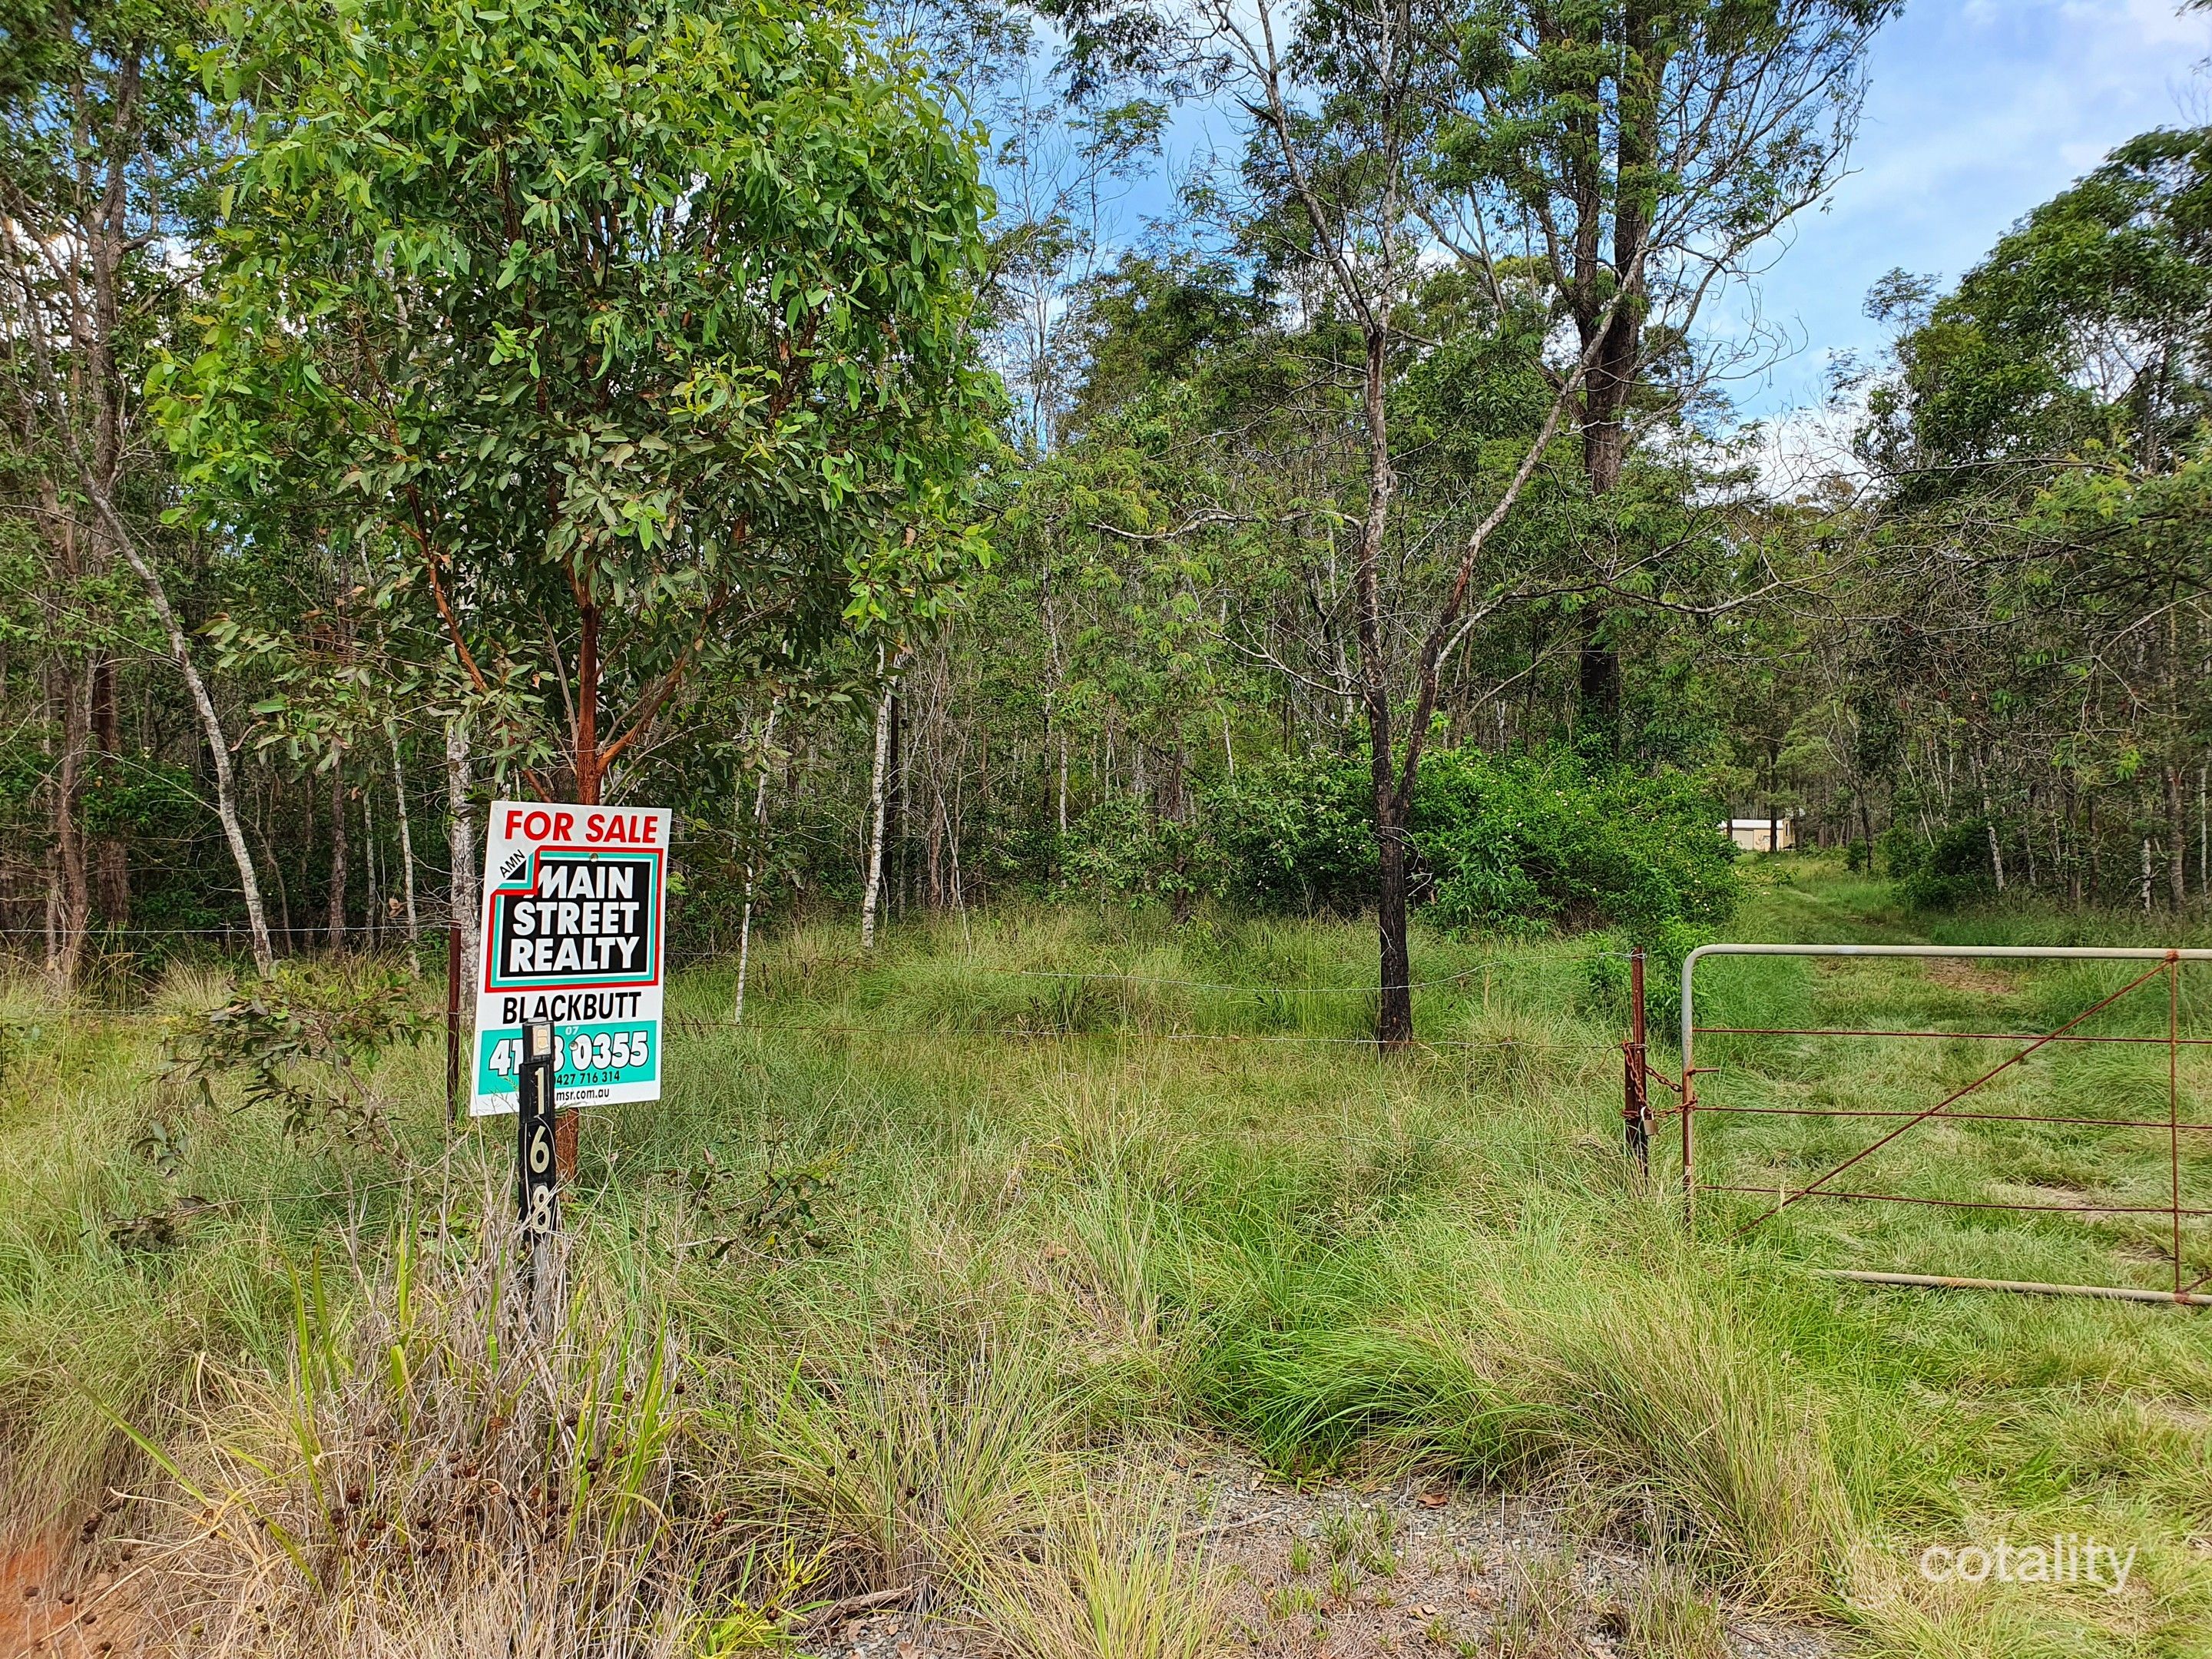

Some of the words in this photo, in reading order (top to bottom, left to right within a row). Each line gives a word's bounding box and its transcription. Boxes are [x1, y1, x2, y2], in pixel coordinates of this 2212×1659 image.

[505, 810, 574, 841] FOR
[585, 814, 658, 843] SALE
[500, 849, 525, 878] AMN
[524, 866, 634, 899] MAIN
[512, 902, 639, 935] STREET
[509, 936, 640, 972] REALTY
[502, 992, 641, 1024] BLACKBUTT
[565, 1025, 579, 1035] 07
[488, 1035, 565, 1077] 413
[570, 1030, 649, 1071] 0355
[554, 1073, 576, 1085] 427
[580, 1072, 598, 1084] 716
[602, 1071, 620, 1082] 314
